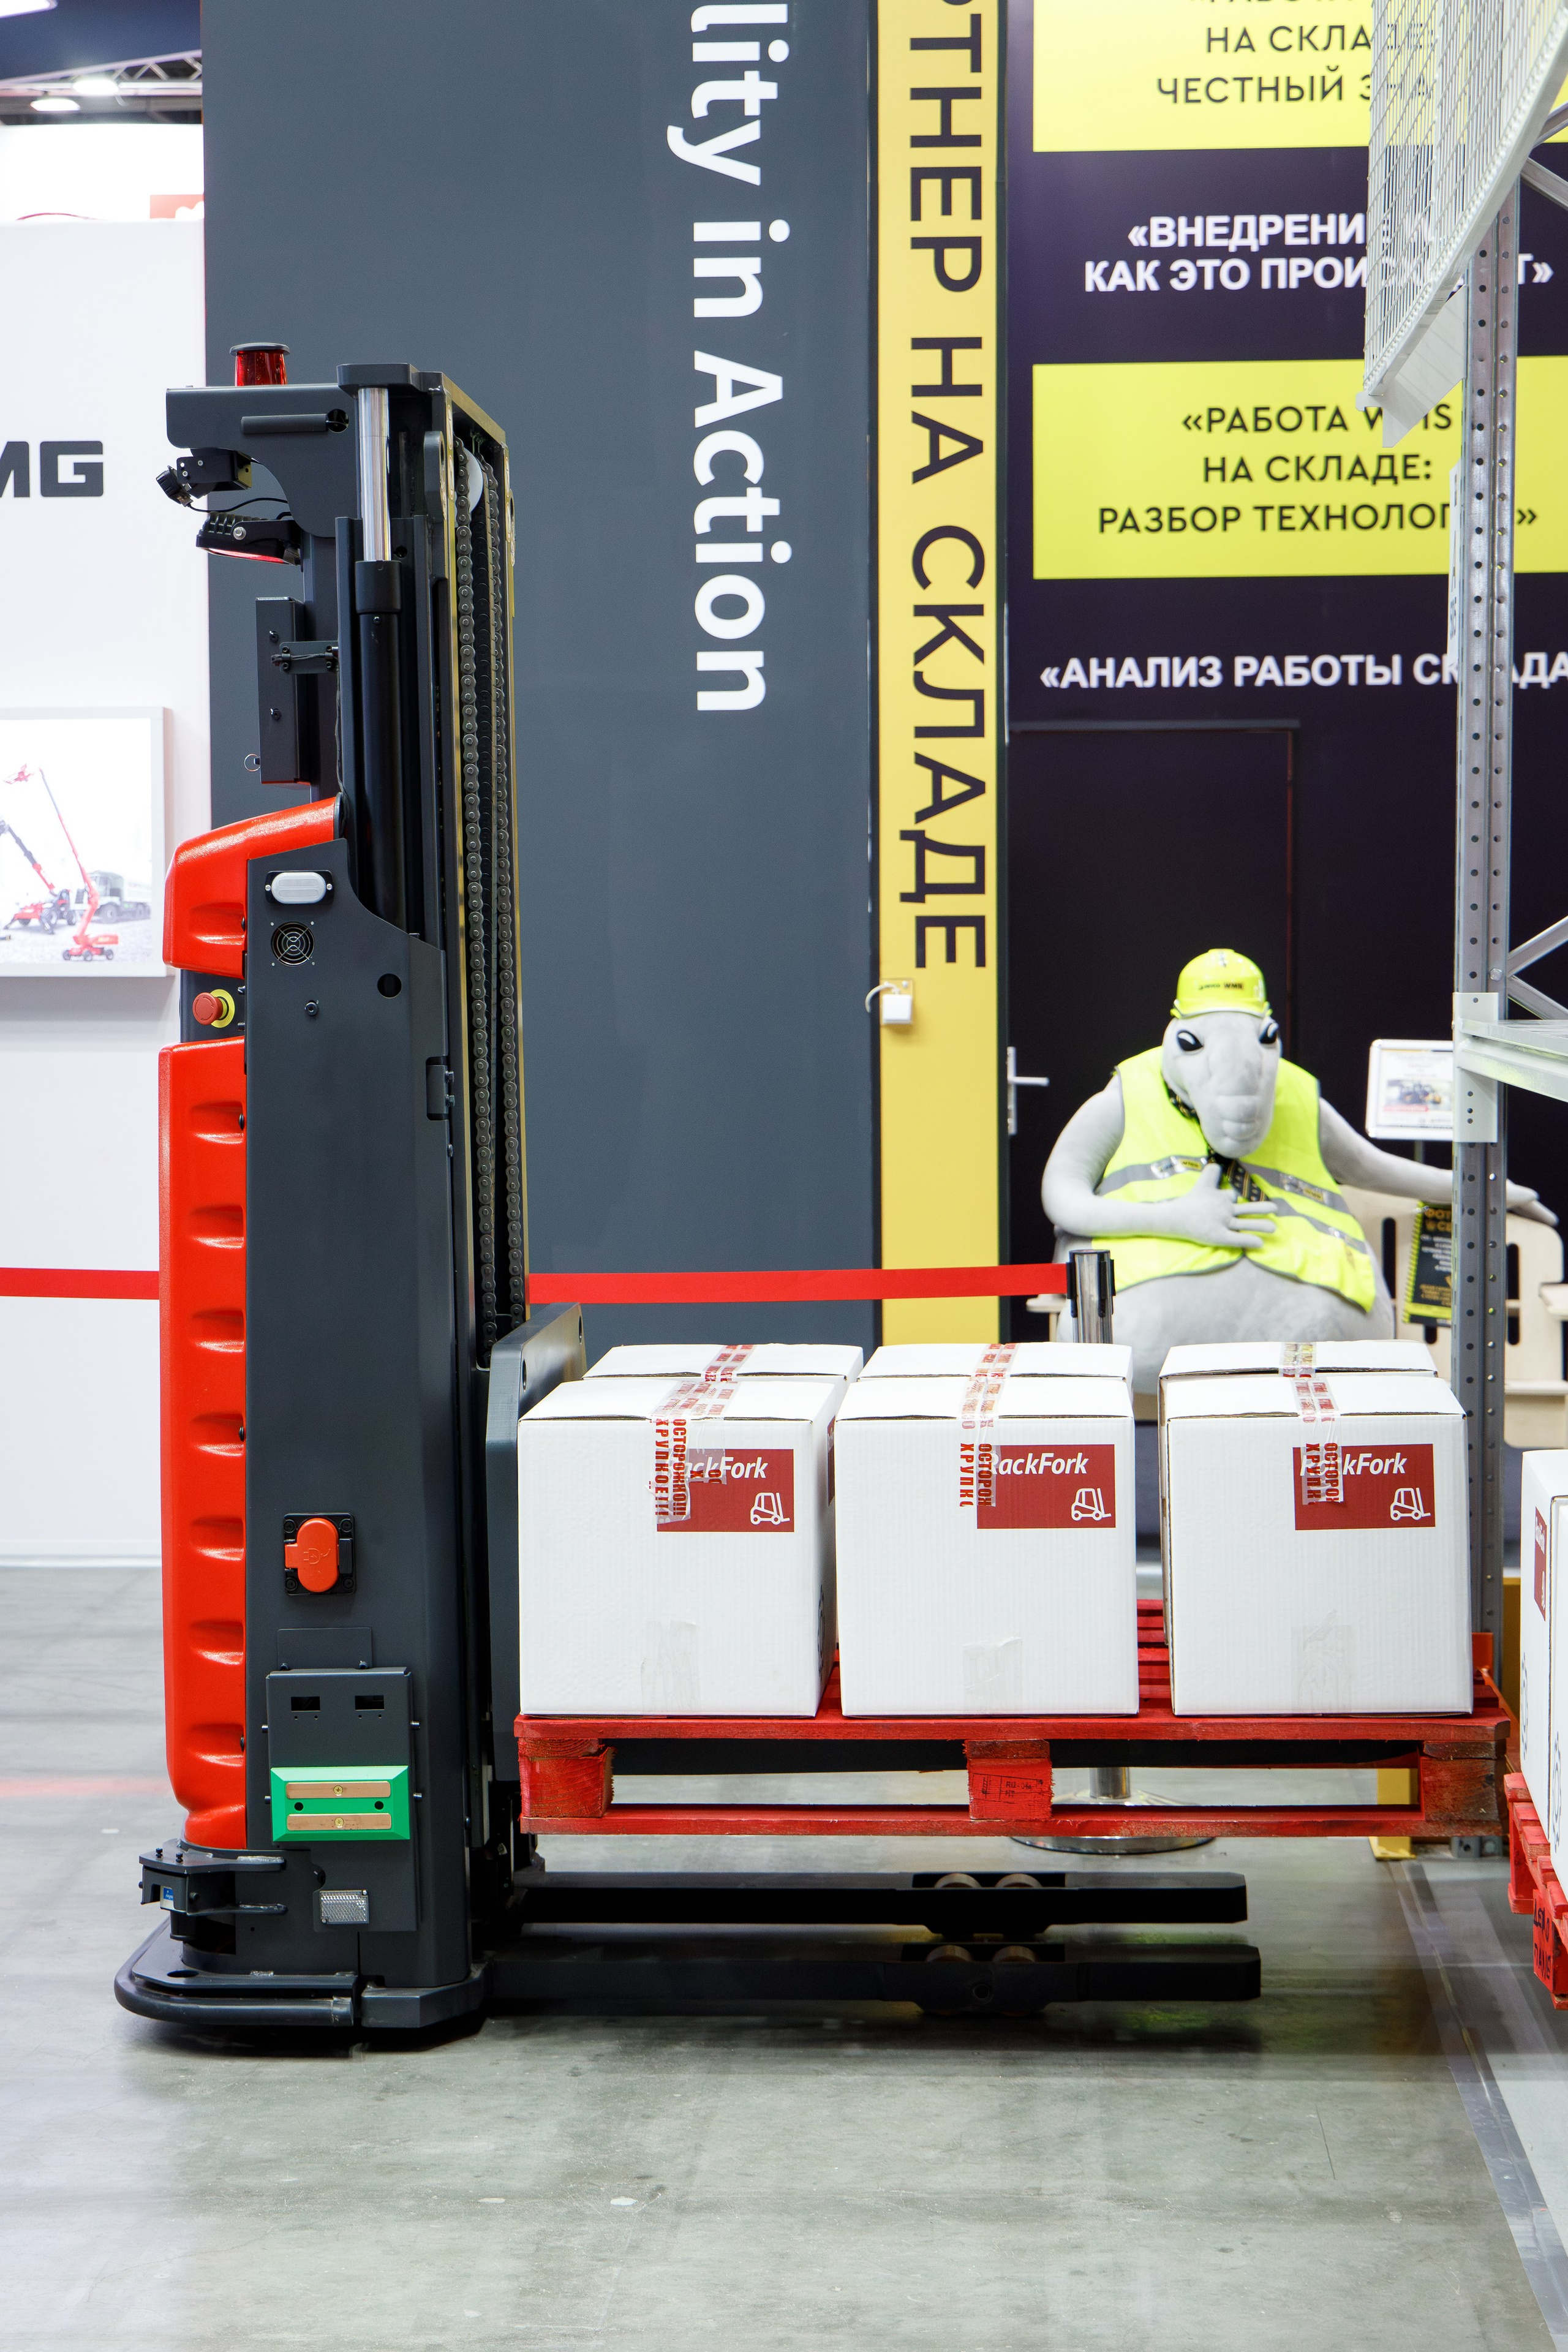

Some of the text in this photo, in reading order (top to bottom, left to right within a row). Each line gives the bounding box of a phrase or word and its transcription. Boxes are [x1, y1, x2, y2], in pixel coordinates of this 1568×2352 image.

[1206, 27, 1256, 53] НА
[1157, 65, 1343, 104] ЧЕСТНЫЙ
[693, 219, 790, 317] in
[1085, 260, 1160, 293] КАК
[1169, 259, 1250, 292] ЭТО
[1182, 406, 1348, 433] «РАБОТА
[899, 0, 986, 968] ТНЕР НА СКЛАДЕ
[1204, 454, 1431, 486] НА СКЛАДЕ:
[693, 350, 792, 712] Action
[1099, 506, 1242, 533] РАЗБОР
[1040, 656, 1223, 689] «АНАЛИЗ
[1234, 654, 1403, 687] РАБОТЫ
